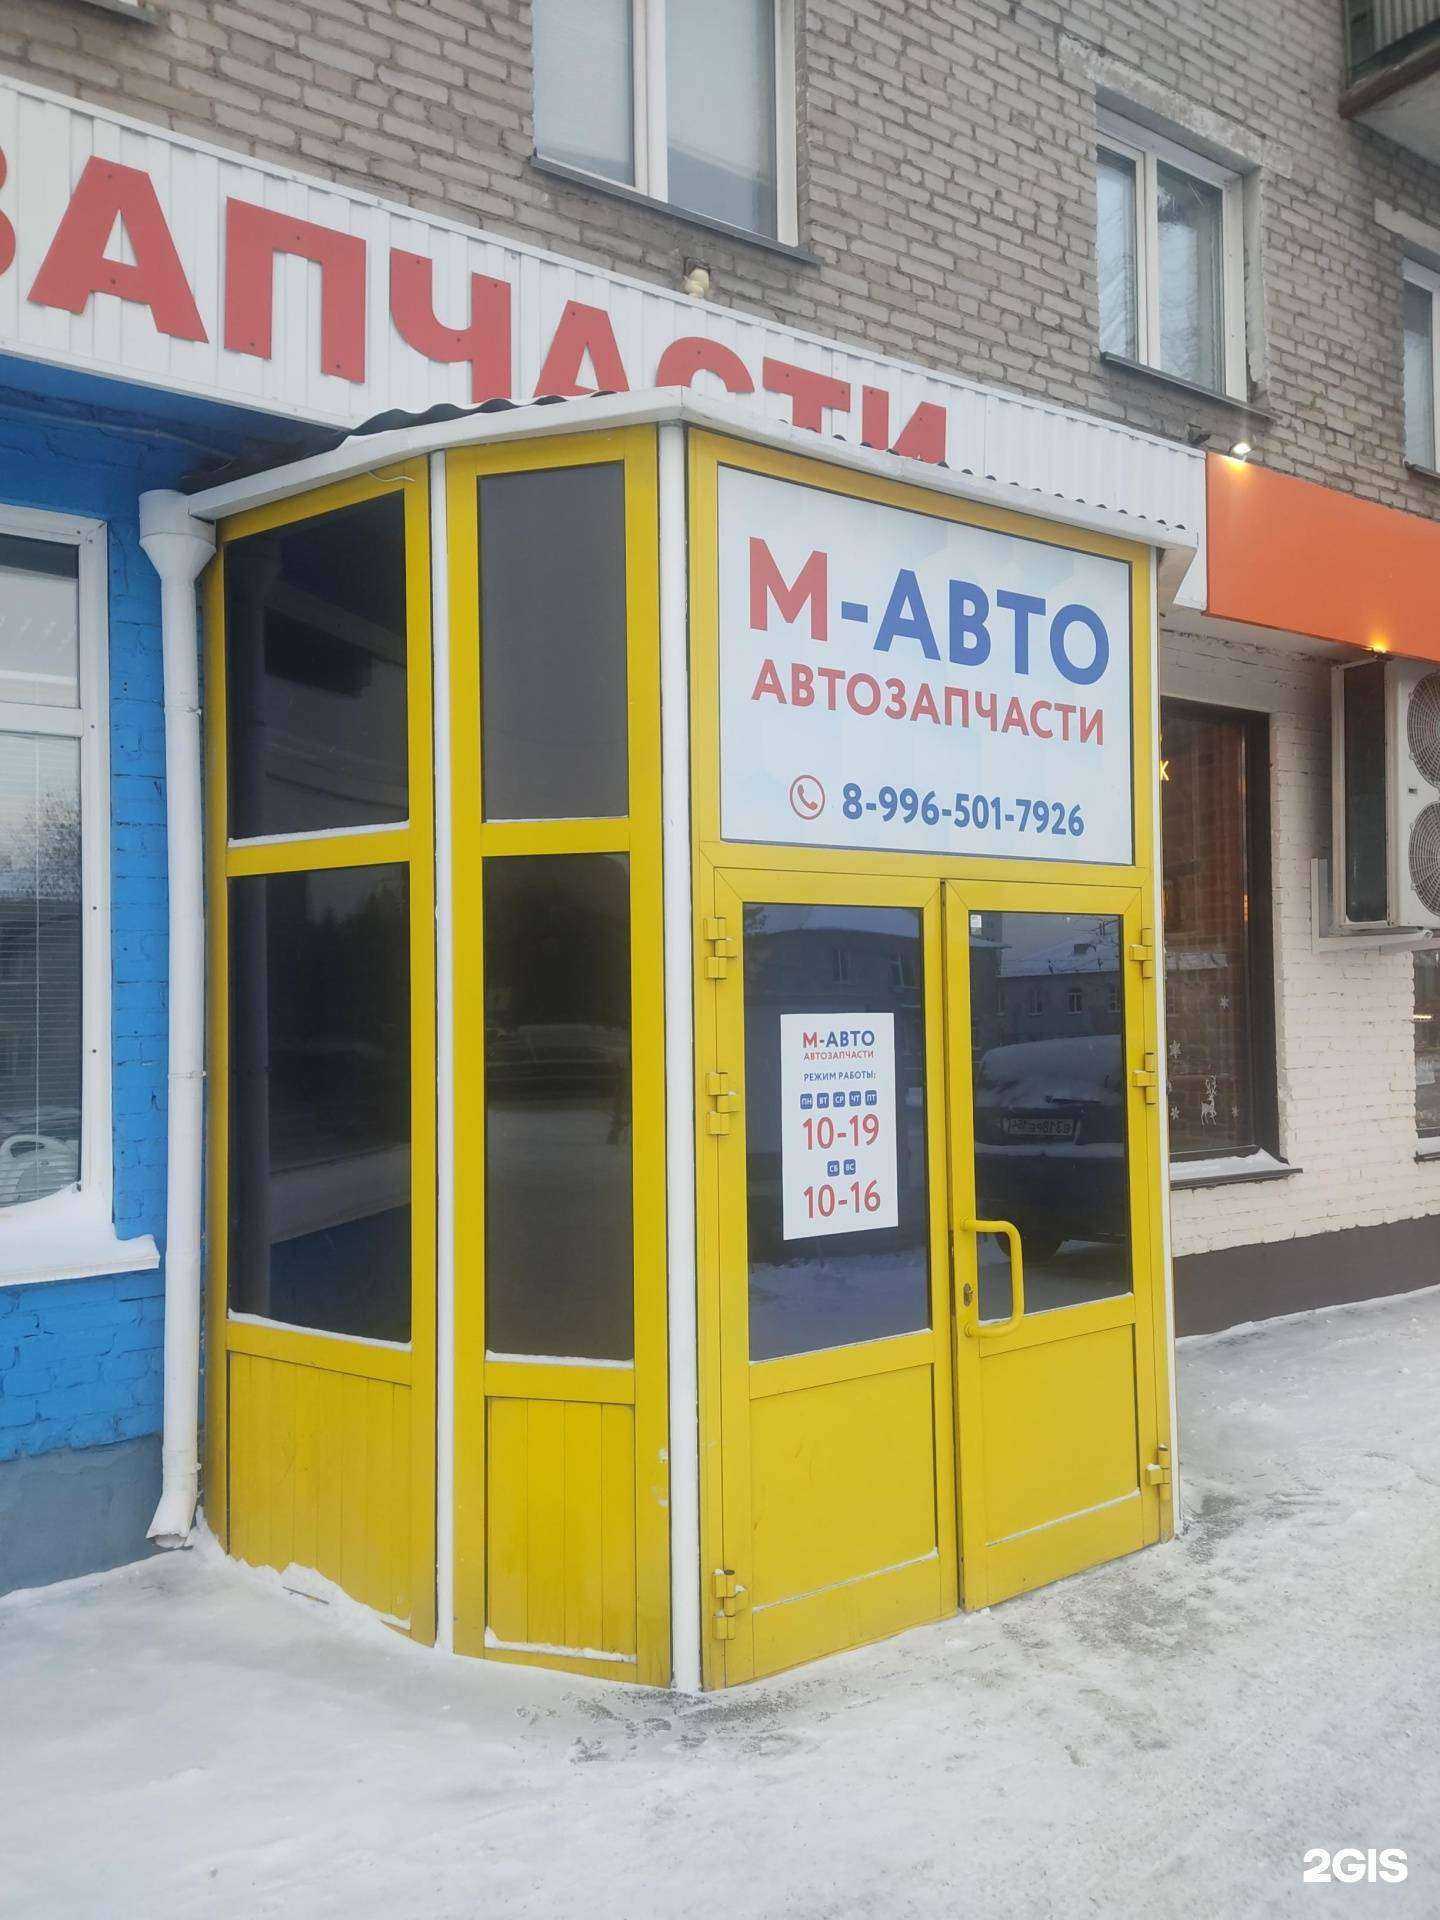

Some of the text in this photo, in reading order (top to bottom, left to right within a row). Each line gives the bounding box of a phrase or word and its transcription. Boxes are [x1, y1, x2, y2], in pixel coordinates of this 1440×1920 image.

[0, 145, 947, 464] АПЧАТИ
[749, 536, 1110, 685] М-АВТО
[751, 658, 1104, 746] АВТОЗАПЧАСТИ
[842, 782, 1085, 837] 8-996-501-7926
[802, 1030, 876, 1049] М-АВТО
[803, 1050, 875, 1061] АВТОЗАПЧАСТИ
[803, 1070, 877, 1082] РЕЖИМ РАБОТЫ:
[801, 1094, 876, 1105] ПН ВТ СР ЧТ ПТ
[802, 1113, 880, 1151] 10-19
[829, 1163, 855, 1173] СБ ВС
[803, 1179, 881, 1219] 10-16
